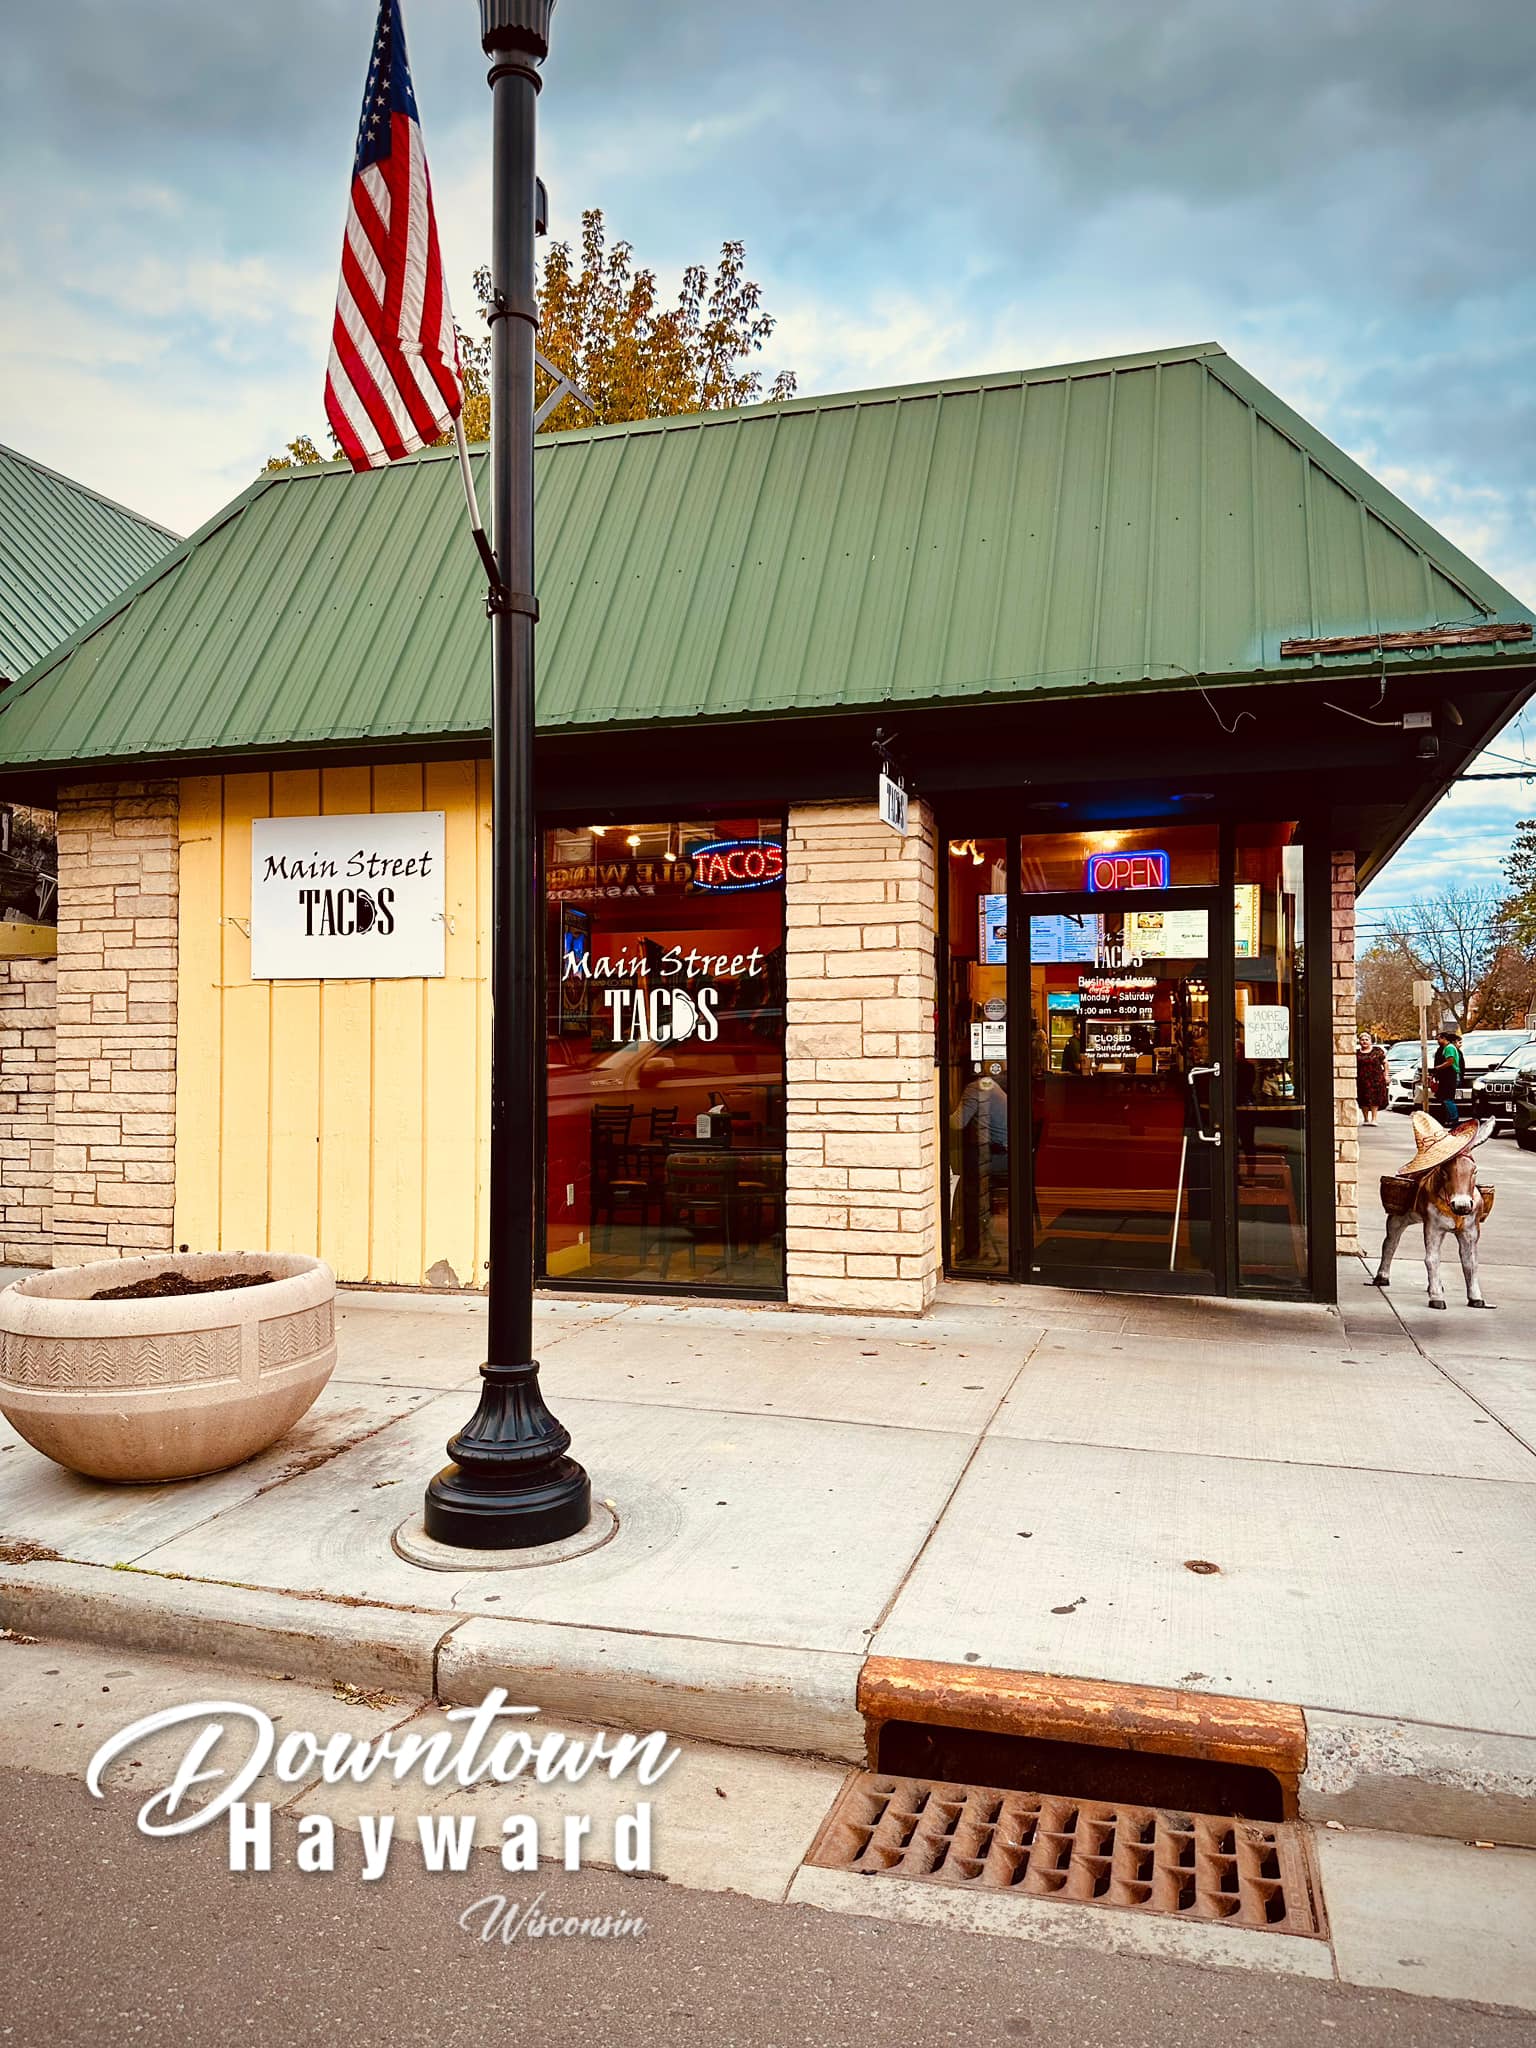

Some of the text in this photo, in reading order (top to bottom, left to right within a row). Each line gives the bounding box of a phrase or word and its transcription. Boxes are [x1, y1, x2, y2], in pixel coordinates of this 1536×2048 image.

[263, 849, 433, 882] Main Street
[692, 848, 783, 882] TACOS
[1094, 856, 1163, 889] OPEN
[299, 887, 395, 937] TACOS
[562, 945, 764, 982] Main Street
[1078, 976, 1121, 988] Business
[1080, 993, 1111, 1004] Monday
[1119, 992, 1155, 1003] Saturday
[604, 987, 719, 1042] TACOS
[1076, 1007, 1097, 1015] 11:00
[1119, 1006, 1138, 1015] 8:00
[1139, 1008, 1153, 1017] pm
[1254, 1010, 1281, 1022] MORE
[1248, 1022, 1289, 1033] SEATING
[1094, 1034, 1132, 1043] CLOSED
[1260, 1033, 1273, 1042] IN
[1095, 1043, 1131, 1053] Sundays
